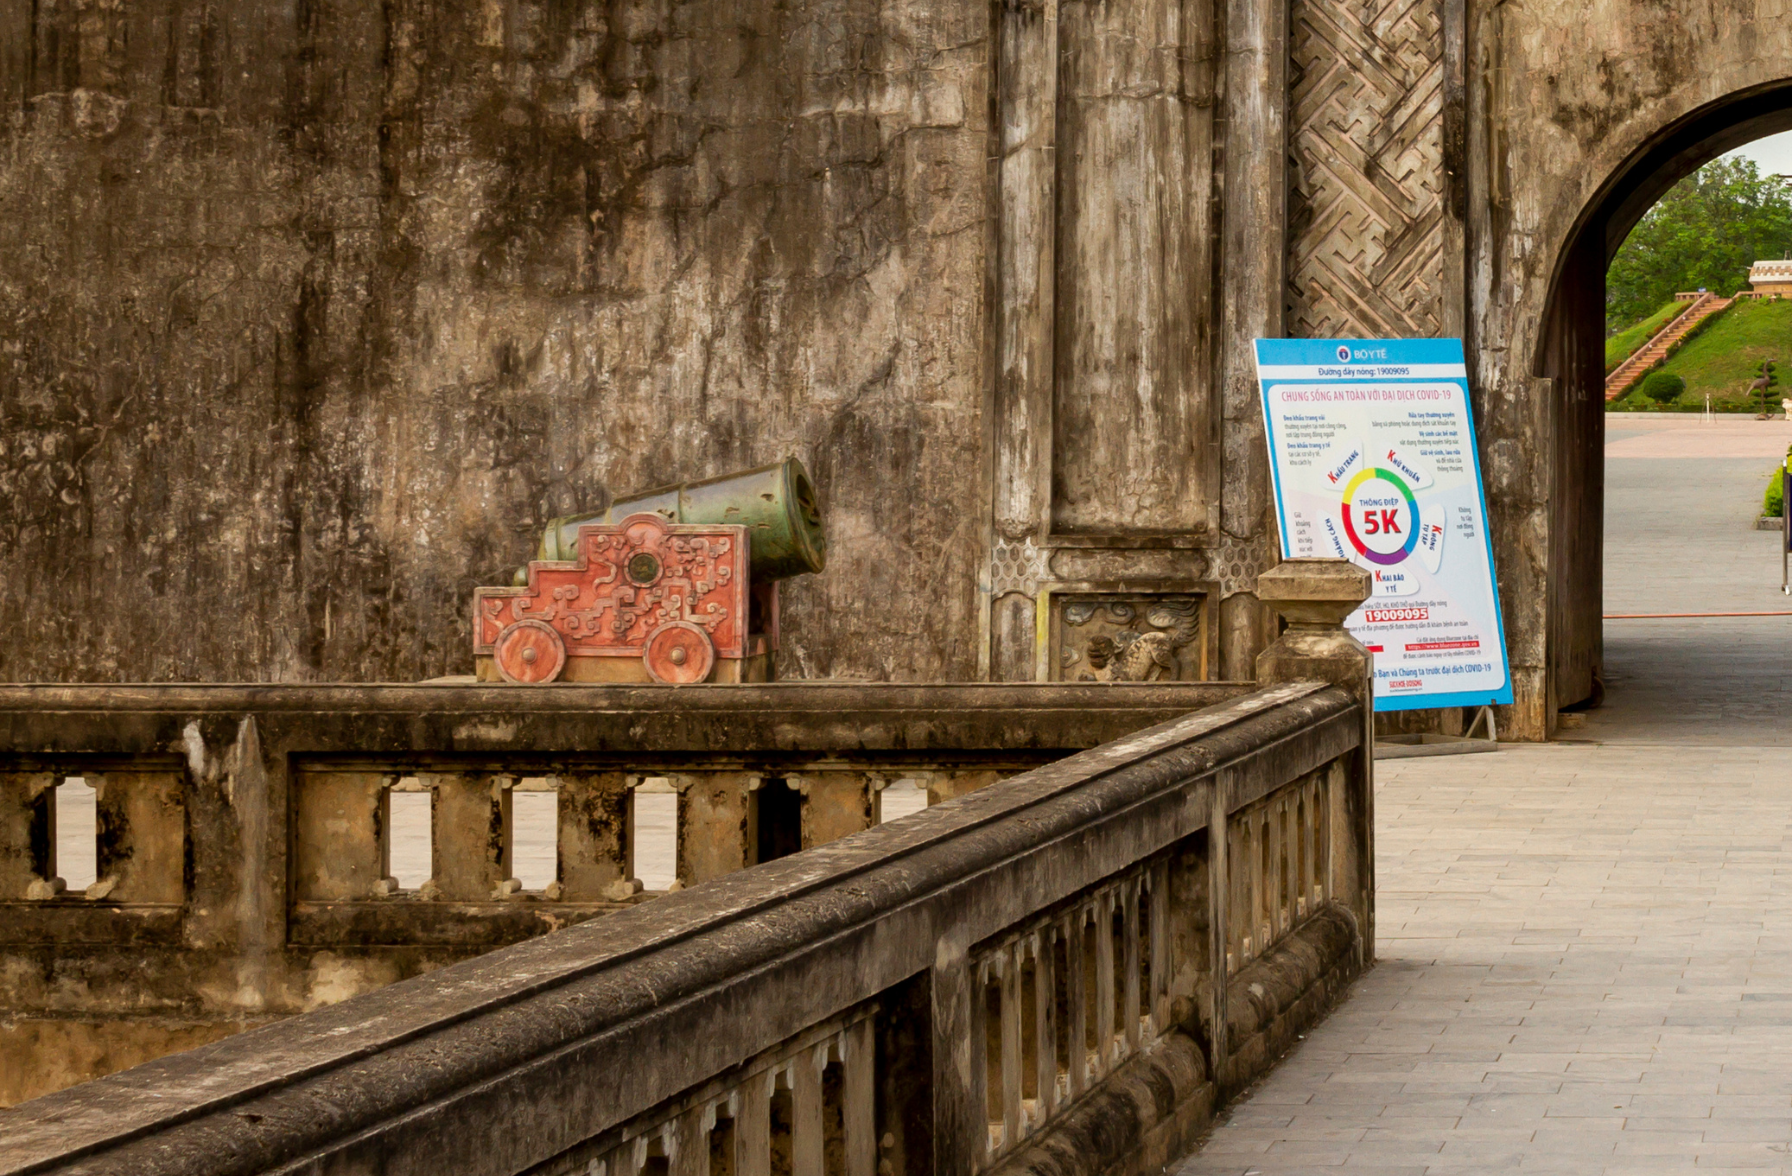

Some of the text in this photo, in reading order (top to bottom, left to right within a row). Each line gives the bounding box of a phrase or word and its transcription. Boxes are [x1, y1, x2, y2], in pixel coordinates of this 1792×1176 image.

[1354, 348, 1387, 360] BỘ Y TẾ
[1318, 367, 1410, 377] Đường dây nóng: 19009095
[1281, 388, 1452, 403] CHUNG SỐNG AN TOÀN VỚI ĐẠI DỊCH COVID-19
[1359, 497, 1399, 507] THÔNG ĐIỆP
[1324, 517, 1336, 536] CÁCH
[1364, 508, 1402, 535] 5K
[1429, 524, 1443, 552] KHÔNG
[1375, 570, 1404, 582] KHAI BÁO
[1366, 608, 1428, 622] 19009095
[1378, 669, 1390, 680] Bạn
[1390, 668, 1398, 677] và
[1399, 668, 1418, 678] Chúng
[1418, 668, 1424, 676] ta
[1425, 666, 1441, 676] trước
[1442, 666, 1451, 676] đại
[1452, 665, 1464, 675] dịch
[1465, 663, 1492, 673] COVID-19
